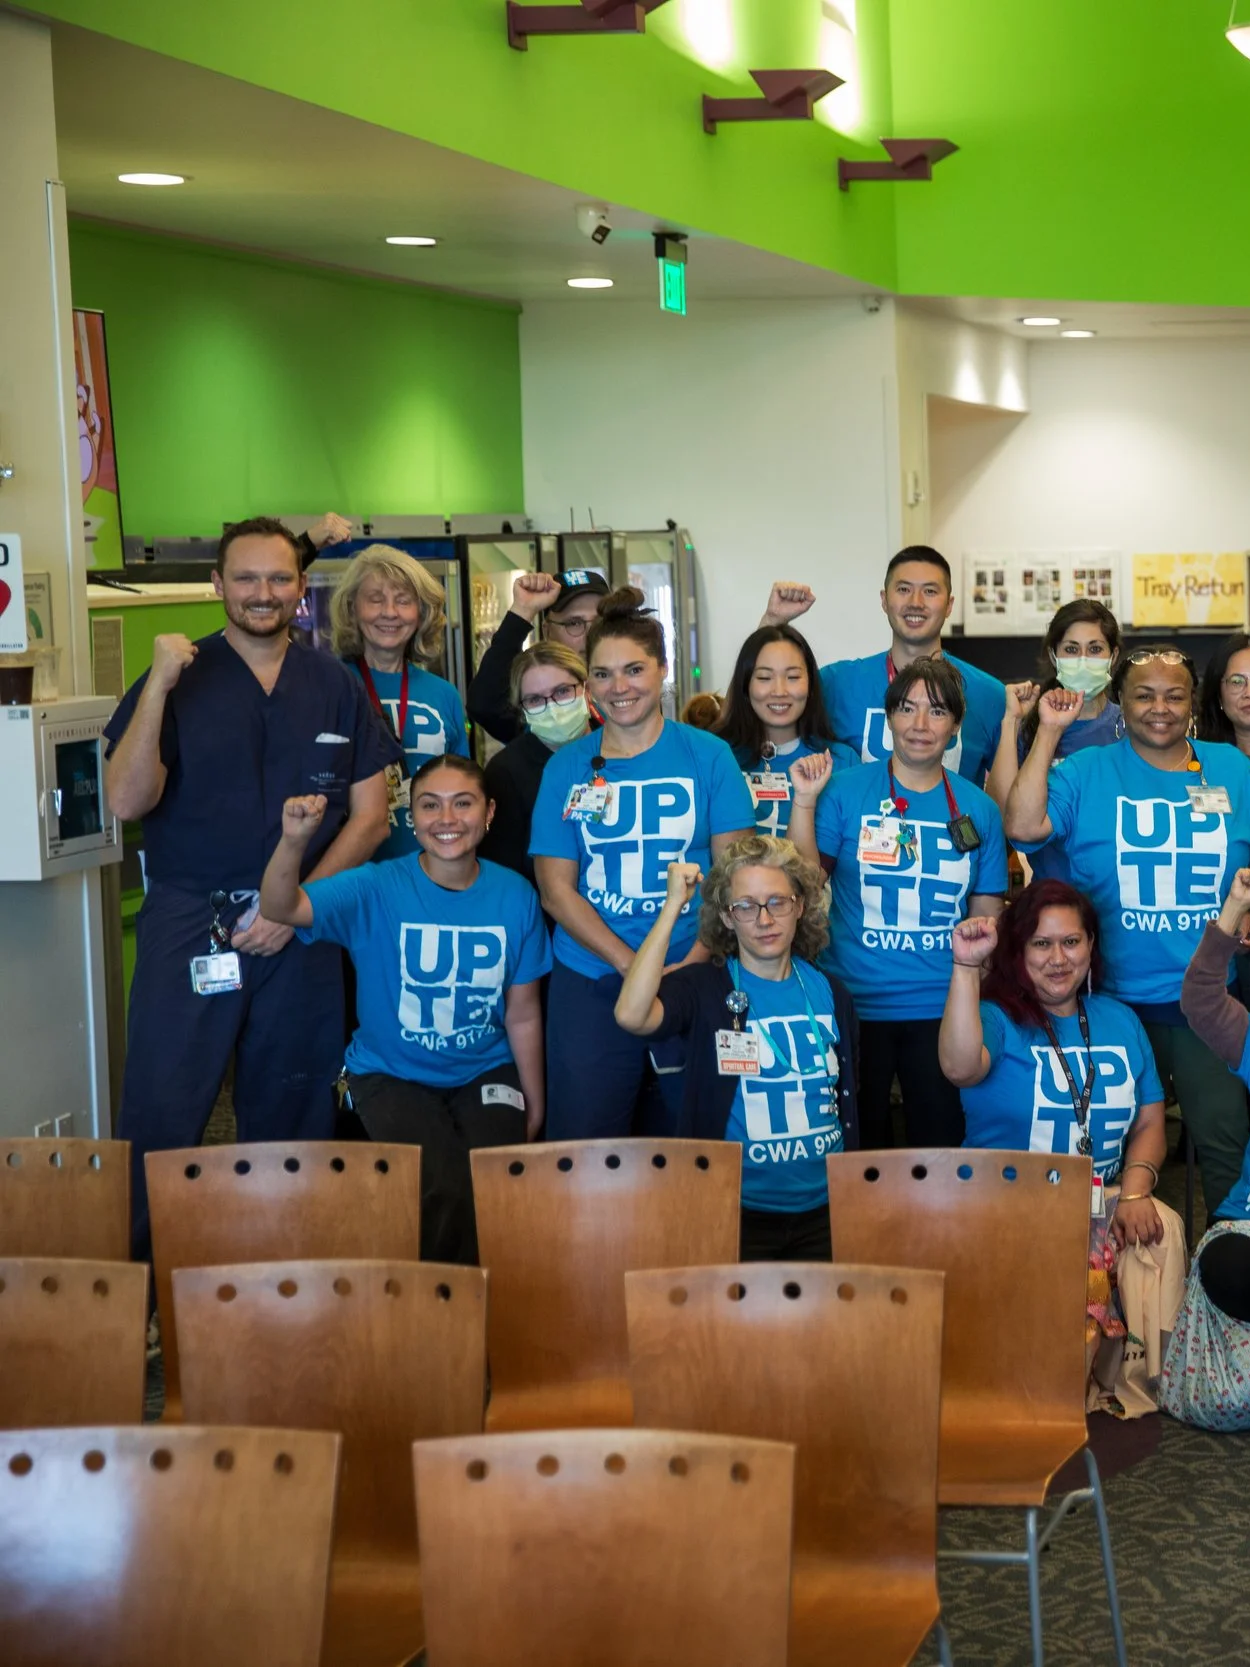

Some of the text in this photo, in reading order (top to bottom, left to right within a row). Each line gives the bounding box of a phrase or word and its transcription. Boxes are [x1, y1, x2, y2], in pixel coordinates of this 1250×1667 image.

[1136, 575, 1180, 603] Tray
[571, 811, 593, 822] PA-C
[1122, 803, 1220, 849] UP
[589, 839, 687, 896] TE
[1121, 852, 1220, 906] TE
[587, 889, 633, 916] CWA
[864, 874, 964, 929] TE
[1122, 911, 1172, 932] CWA
[405, 928, 502, 985] UP
[862, 931, 915, 951] CWA
[405, 985, 499, 1031] TE
[400, 1029, 448, 1050] CWA
[1040, 1050, 1128, 1105] UP
[746, 1077, 840, 1134] TE
[749, 1139, 808, 1163] CWA
[1037, 1107, 1132, 1164] TE
